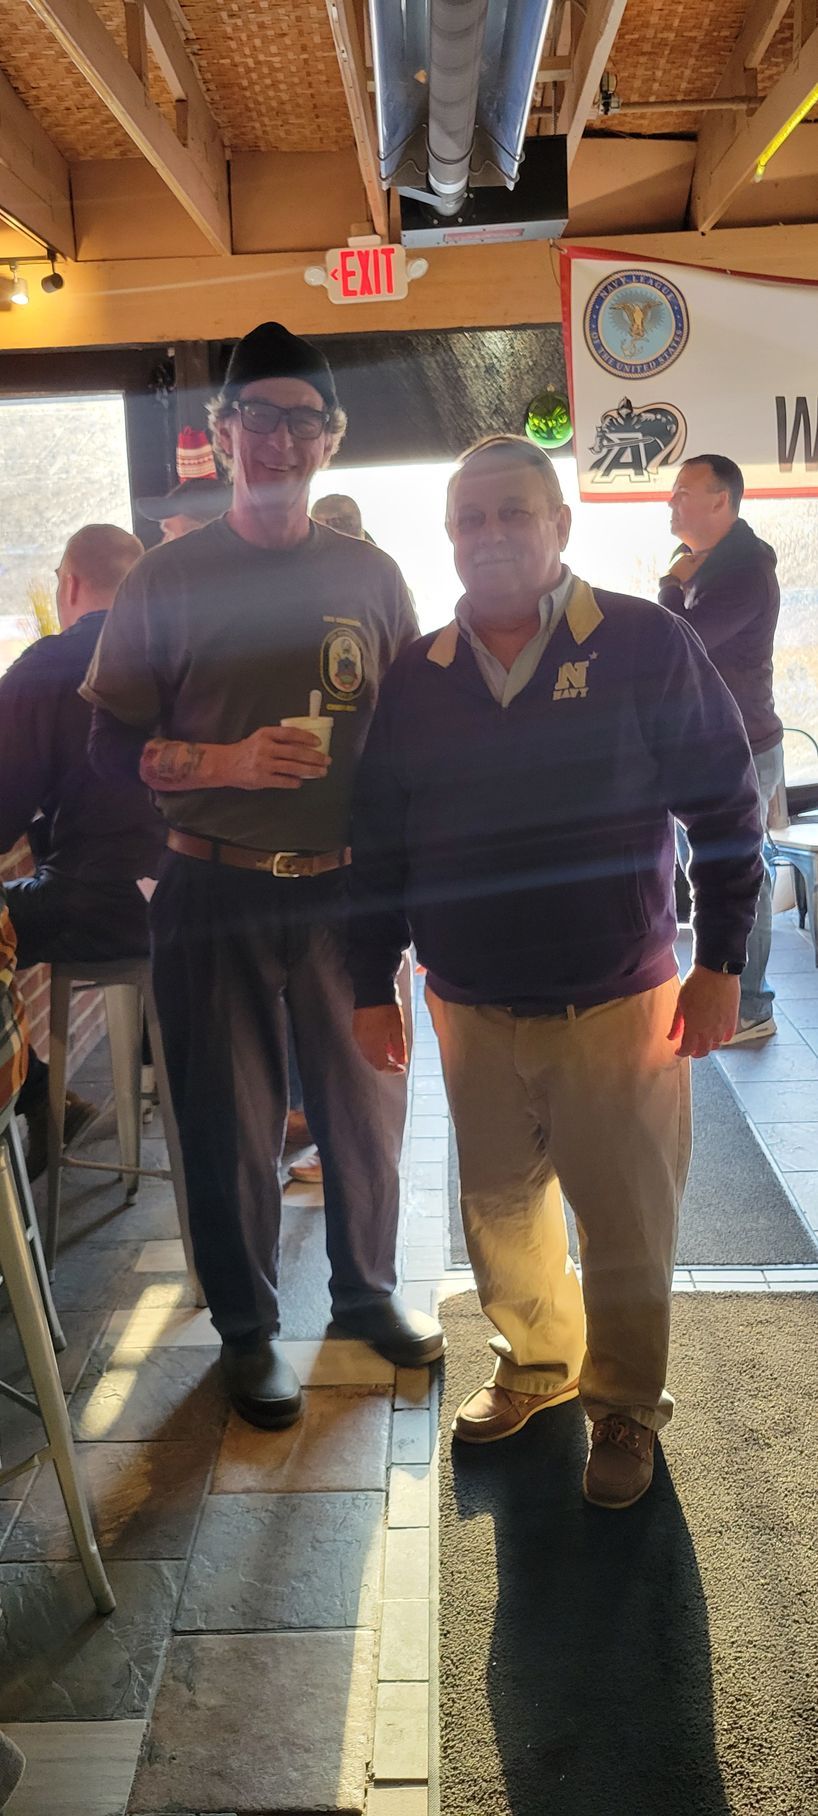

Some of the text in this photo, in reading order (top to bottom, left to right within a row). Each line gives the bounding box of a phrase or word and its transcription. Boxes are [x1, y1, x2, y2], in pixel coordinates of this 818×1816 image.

[340, 247, 395, 297] EXIT
[600, 275, 674, 300] NAVY LEAGUE
[598, 347, 614, 365] THE
[616, 361, 657, 373] UNITED
[657, 329, 683, 363] STATES
[554, 660, 590, 690] N
[552, 687, 590, 701] NAVY
